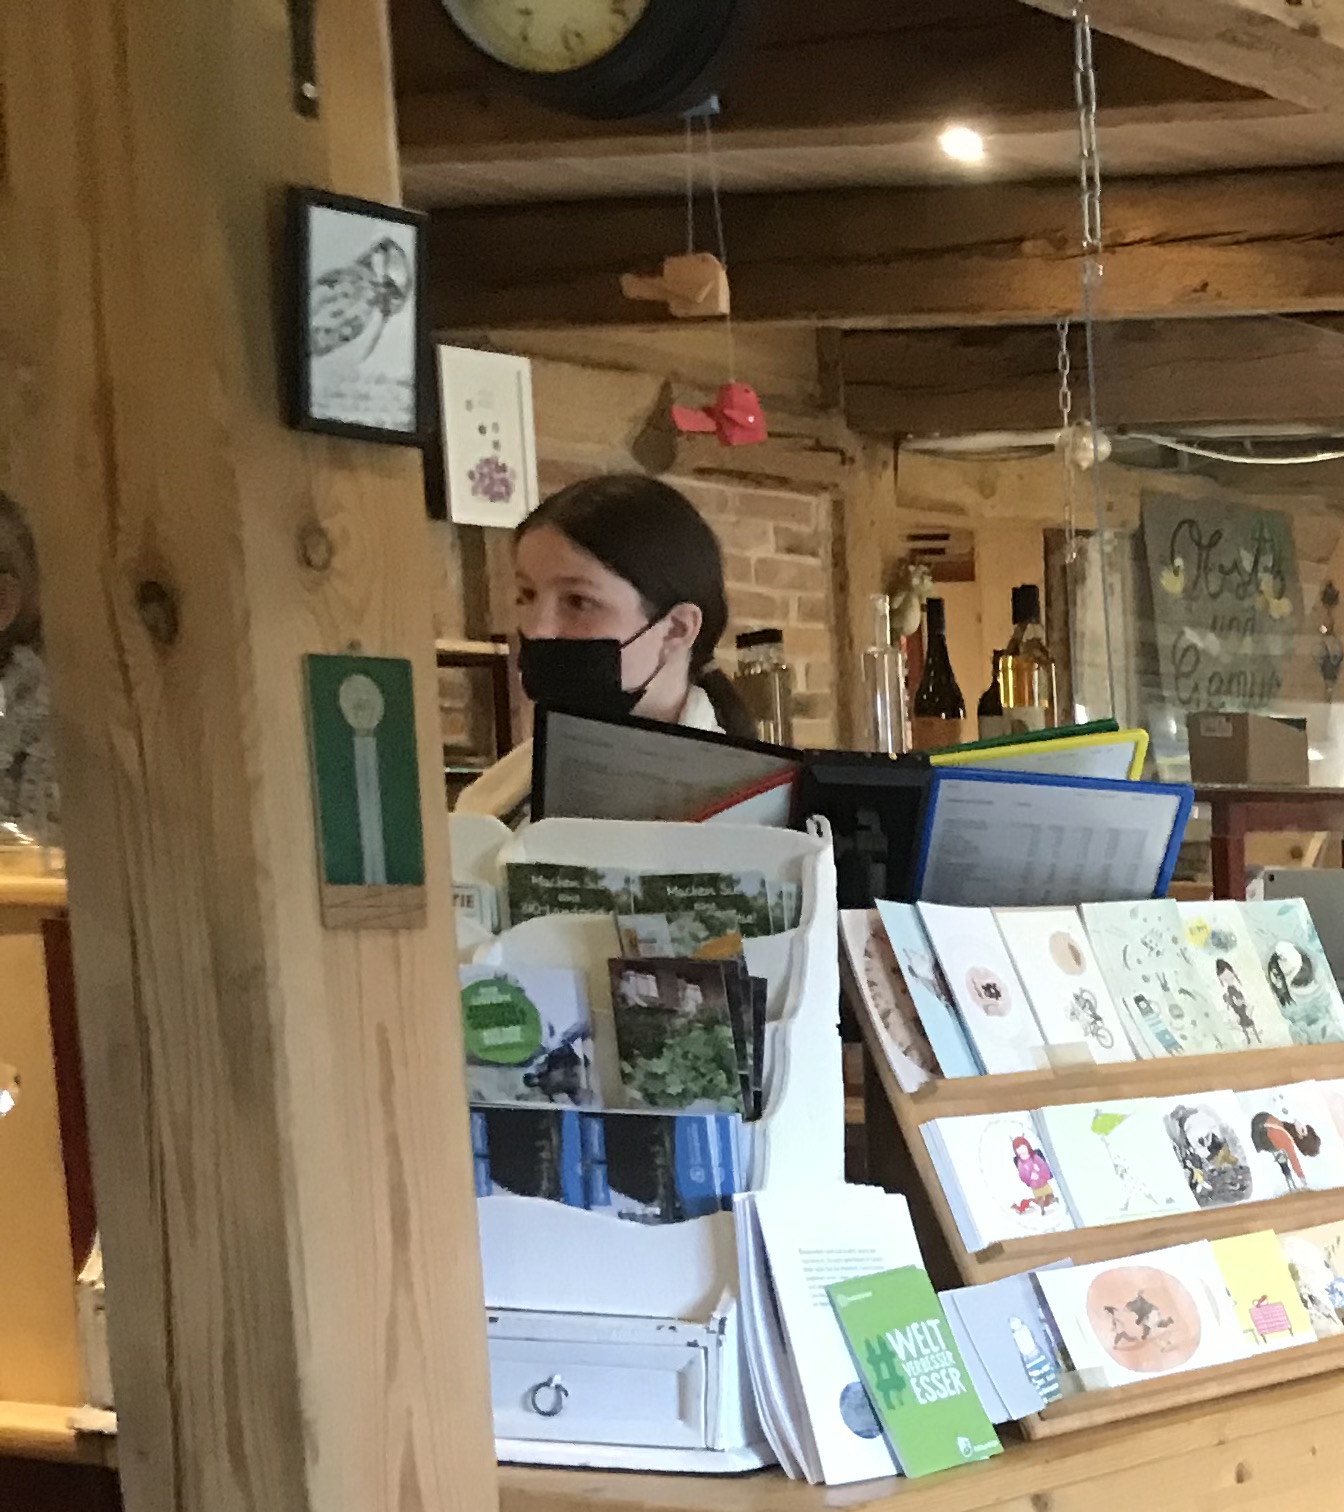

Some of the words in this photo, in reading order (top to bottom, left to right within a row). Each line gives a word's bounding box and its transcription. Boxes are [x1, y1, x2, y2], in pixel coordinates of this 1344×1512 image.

[886, 1317, 948, 1361] WELT
[902, 1351, 957, 1379] VERBESSER
[908, 1368, 968, 1406] ESSER
